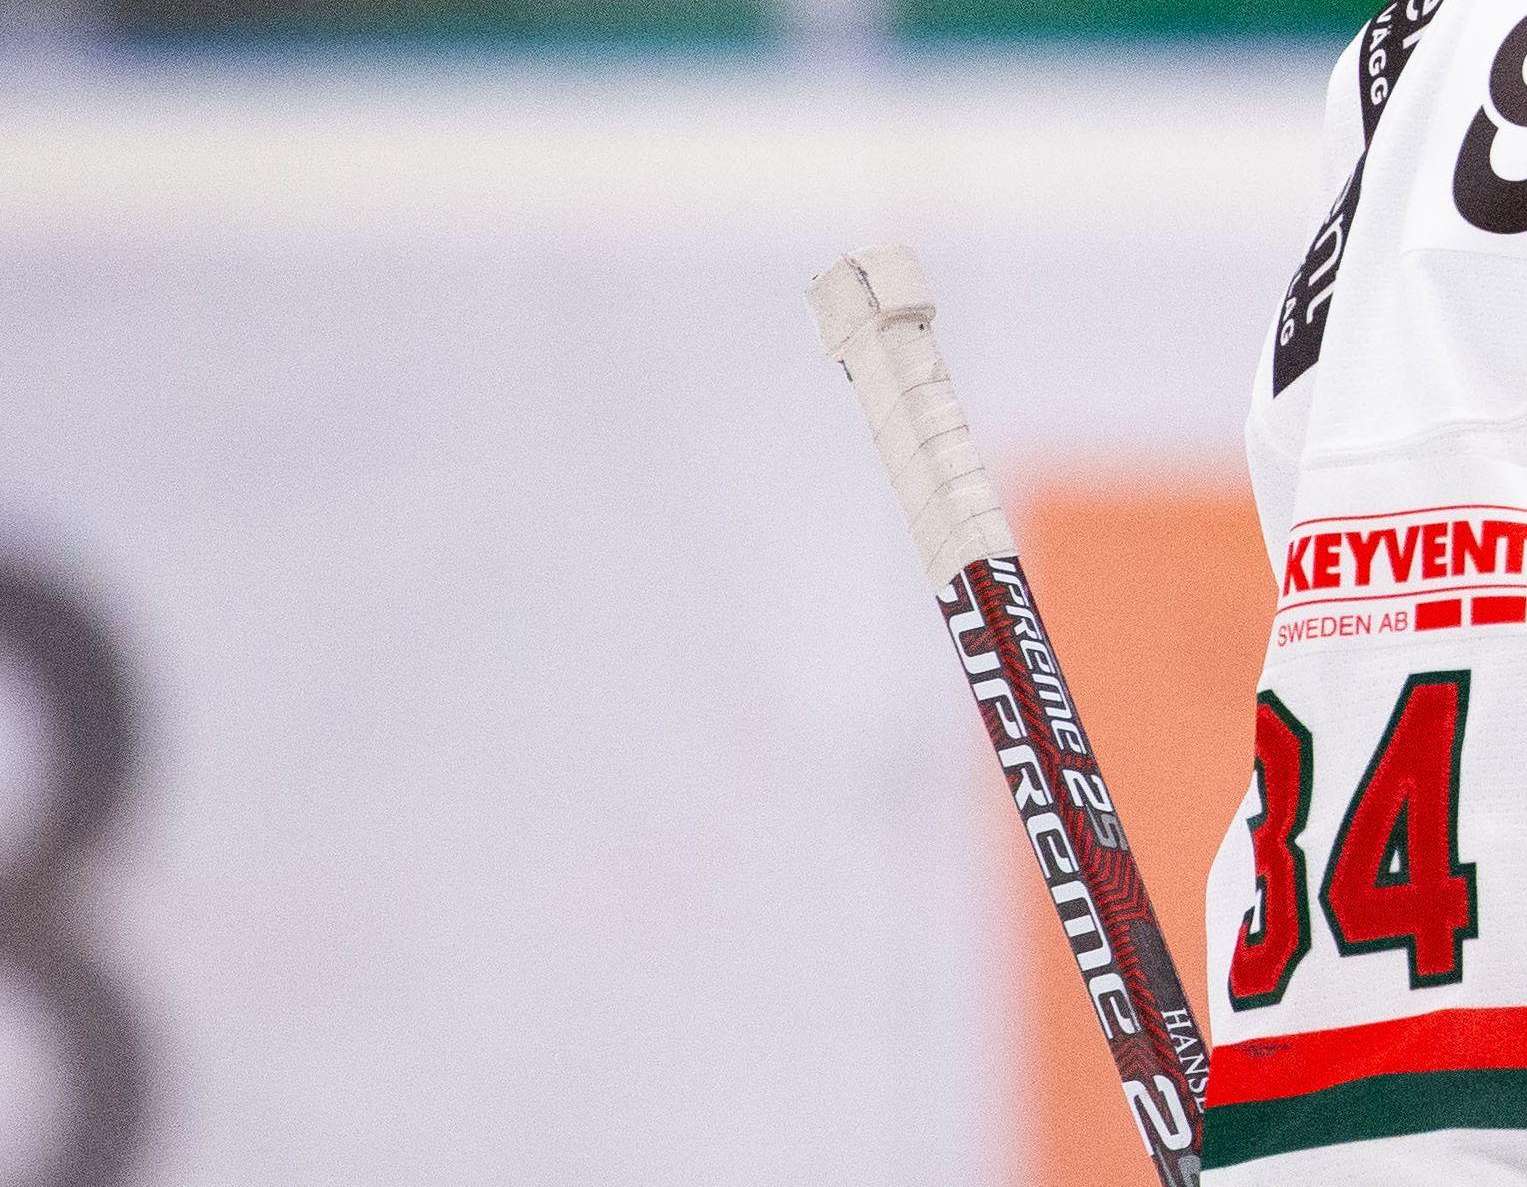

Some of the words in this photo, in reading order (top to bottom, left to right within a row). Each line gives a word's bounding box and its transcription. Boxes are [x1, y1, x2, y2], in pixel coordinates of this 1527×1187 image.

[1278, 615, 1371, 647] SWEDEN
[1379, 611, 1408, 633] AB
[1063, 769, 1128, 851] 25
[1228, 669, 1480, 1012] 34
